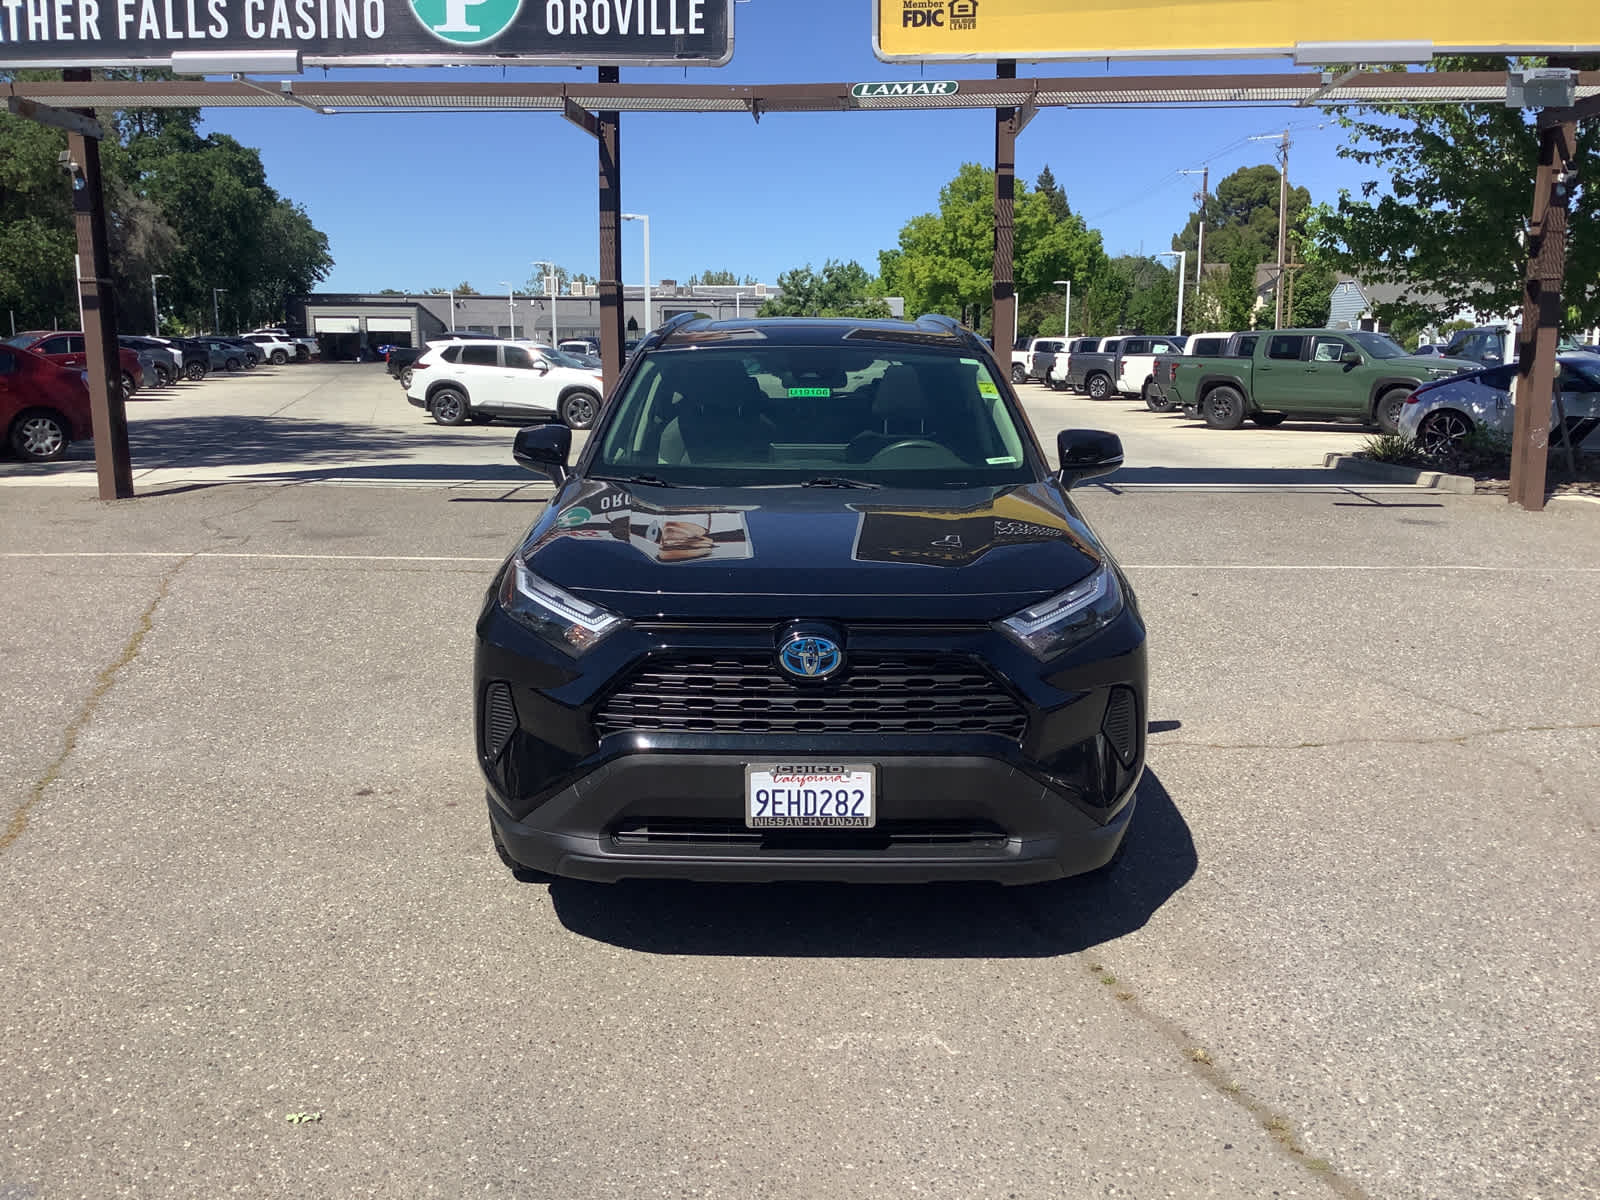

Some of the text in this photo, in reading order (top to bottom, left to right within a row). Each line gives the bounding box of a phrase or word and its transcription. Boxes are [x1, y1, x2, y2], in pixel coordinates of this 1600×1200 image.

[903, 0, 944, 8] Member
[0, 0, 385, 41] THER FALLS CASINO
[546, 0, 705, 35] OROVILLE
[902, 9, 944, 27] FDIC
[860, 83, 948, 96] LAMAR
[777, 766, 844, 774] CHICO
[774, 773, 850, 787] California
[756, 789, 865, 817] 9EHD282
